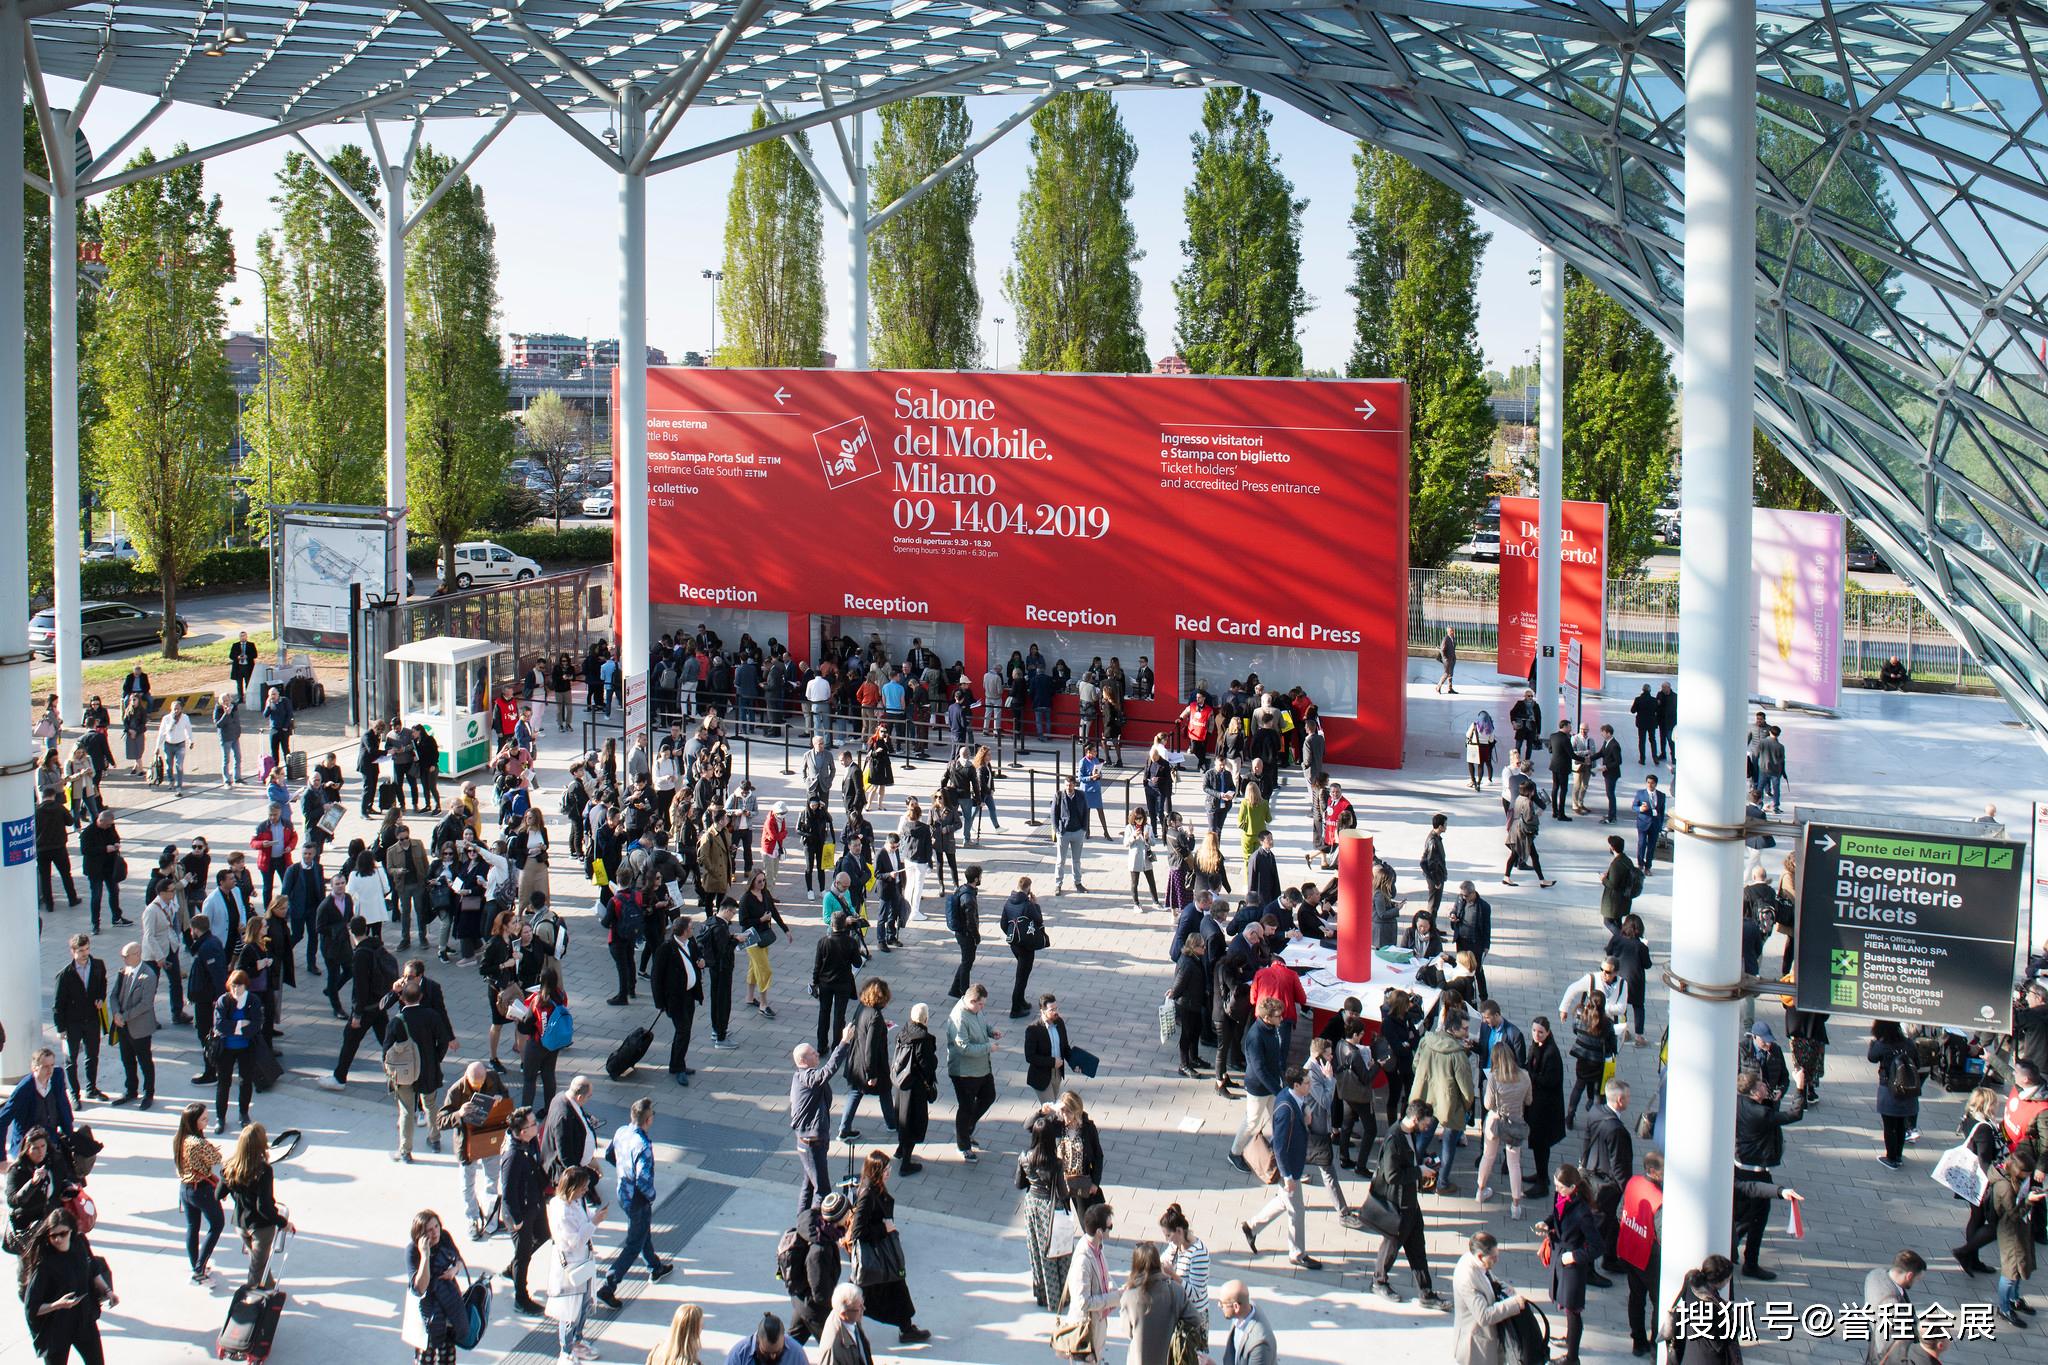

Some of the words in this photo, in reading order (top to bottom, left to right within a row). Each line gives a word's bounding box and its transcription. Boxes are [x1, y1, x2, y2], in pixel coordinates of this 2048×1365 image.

[895, 387, 996, 421] Salone
[647, 417, 670, 428] olare
[672, 420, 708, 429] esterna
[647, 431, 660, 441] ttle
[663, 431, 679, 442] Bus
[894, 425, 939, 457] del
[944, 426, 1053, 461] Mobile.
[1161, 432, 1209, 446] Ingresso
[1212, 434, 1263, 447] visitatori
[647, 452, 669, 461] resso
[670, 451, 706, 463] Stampa
[708, 453, 733, 463] Porta
[735, 453, 754, 464] Sud
[767, 456, 781, 465] TIM
[1161, 450, 1168, 458] e
[1170, 448, 1215, 462] Stampa
[1216, 451, 1238, 461] con
[1240, 450, 1291, 465] biglietto
[653, 465, 691, 474] entrance
[693, 465, 715, 476] Gate
[717, 466, 743, 477] South
[753, 469, 767, 478] TIM
[1161, 462, 1193, 474] Ticket
[892, 462, 997, 497] Milano
[1161, 477, 1181, 488] and
[1183, 478, 1239, 491] accredited
[1242, 480, 1269, 492] Press
[1271, 482, 1320, 494] entrance
[653, 482, 699, 495] collettivo
[659, 497, 674, 507] taxi
[893, 498, 1111, 540] 09_14.04.2019
[1520, 520, 1574, 543] Den
[893, 536, 914, 544] Orario
[915, 536, 922, 544] di
[923, 538, 953, 546] apertura:
[954, 538, 969, 546] 9.30
[974, 540, 992, 548] 18.30
[893, 545, 920, 555] Opening
[1505, 540, 1597, 565] inCoerto!
[679, 583, 757, 605] Reception
[844, 593, 928, 615] Reception
[1026, 604, 1117, 627] Reception
[1175, 614, 1211, 634] Red
[1216, 617, 1261, 637] Card
[1267, 620, 1304, 640] and
[1310, 624, 1361, 644] Press
[1846, 841, 1888, 856] Ponte
[1892, 844, 1914, 857] dei
[1919, 846, 1951, 860] Mari
[1838, 859, 1956, 887] Reception
[1836, 880, 1963, 909] Biglietterie
[1834, 900, 1917, 925] Tickets
[1864, 941, 1890, 950] FIERA
[1893, 944, 1928, 954] MILANO
[1930, 948, 1948, 957] SPA
[1864, 952, 1907, 965] Business
[1910, 957, 1935, 968] Point
[1863, 962, 1895, 973] Centro
[1897, 965, 1928, 976] Servizi
[1863, 971, 1898, 982] Service
[1900, 975, 1931, 985] Centre
[1862, 982, 1894, 993] Centro
[1896, 985, 1943, 998] Congressi
[1862, 991, 1907, 1003] Congress
[1909, 996, 1940, 1007] Centre
[1862, 1000, 1889, 1011] Stella
[1892, 1004, 1923, 1015] Polare
